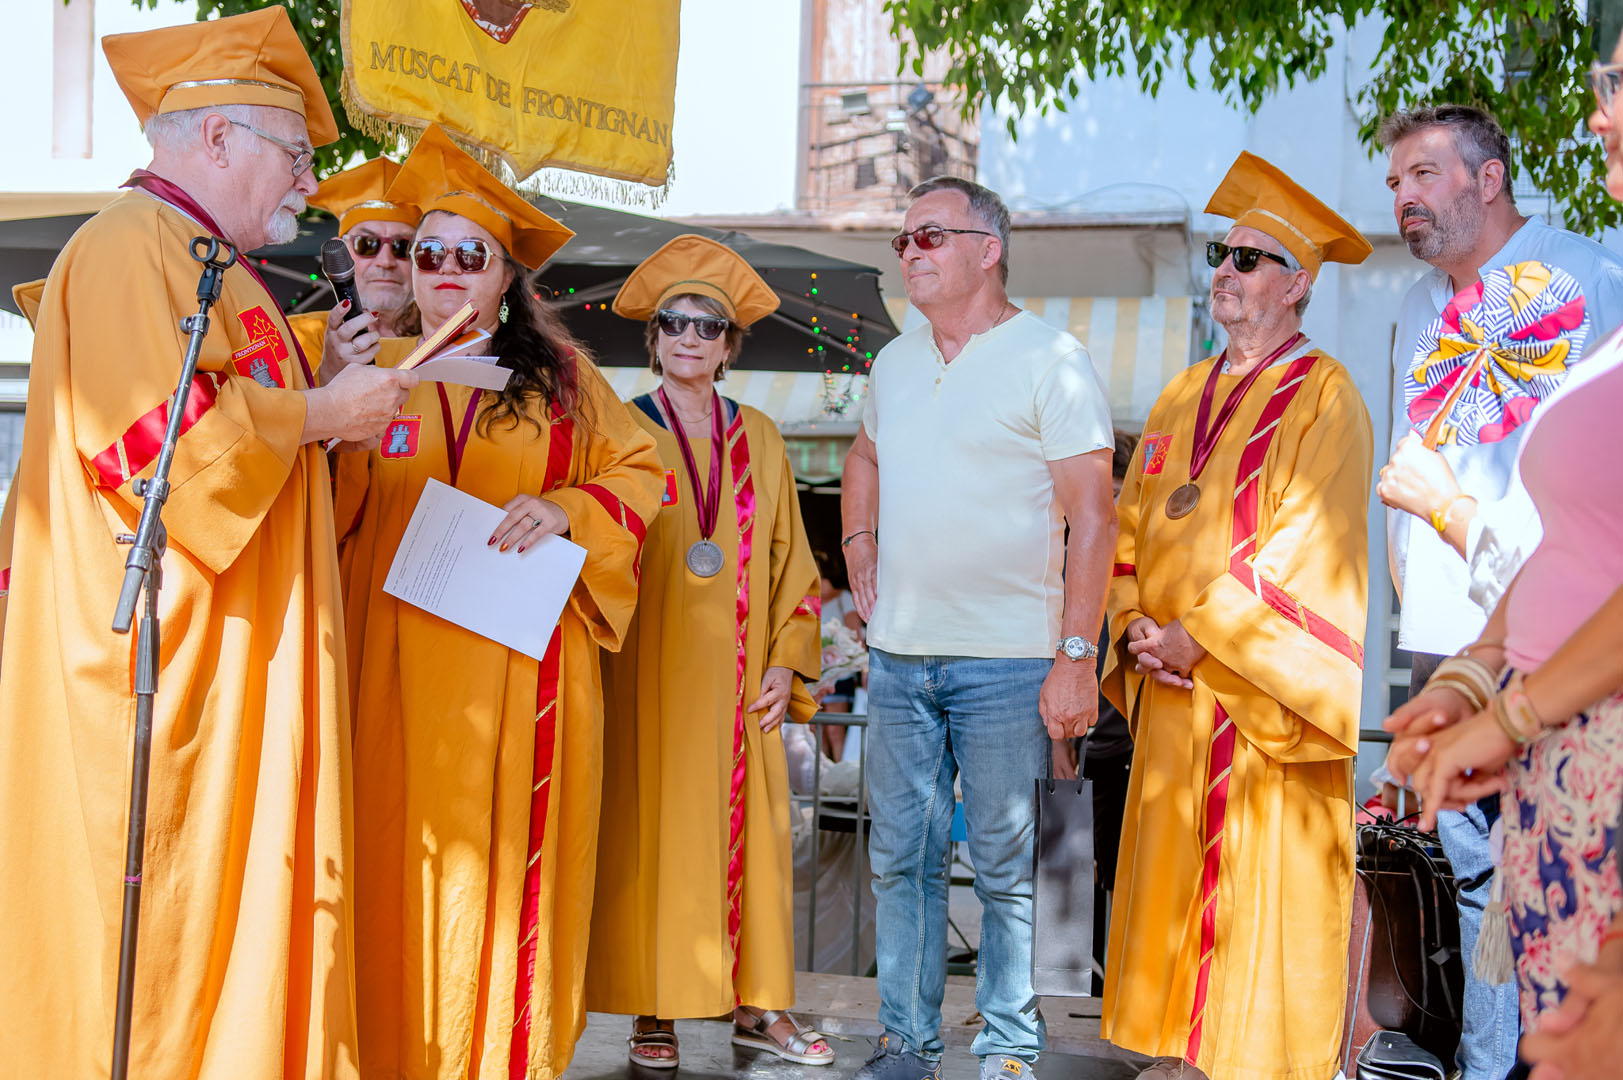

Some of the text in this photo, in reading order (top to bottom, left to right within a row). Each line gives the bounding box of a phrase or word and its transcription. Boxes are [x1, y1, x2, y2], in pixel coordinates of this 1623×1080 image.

[370, 42, 668, 146] MUSCAT DE FRONTIGNAN
[234, 340, 266, 358] FRONTIGNAN
